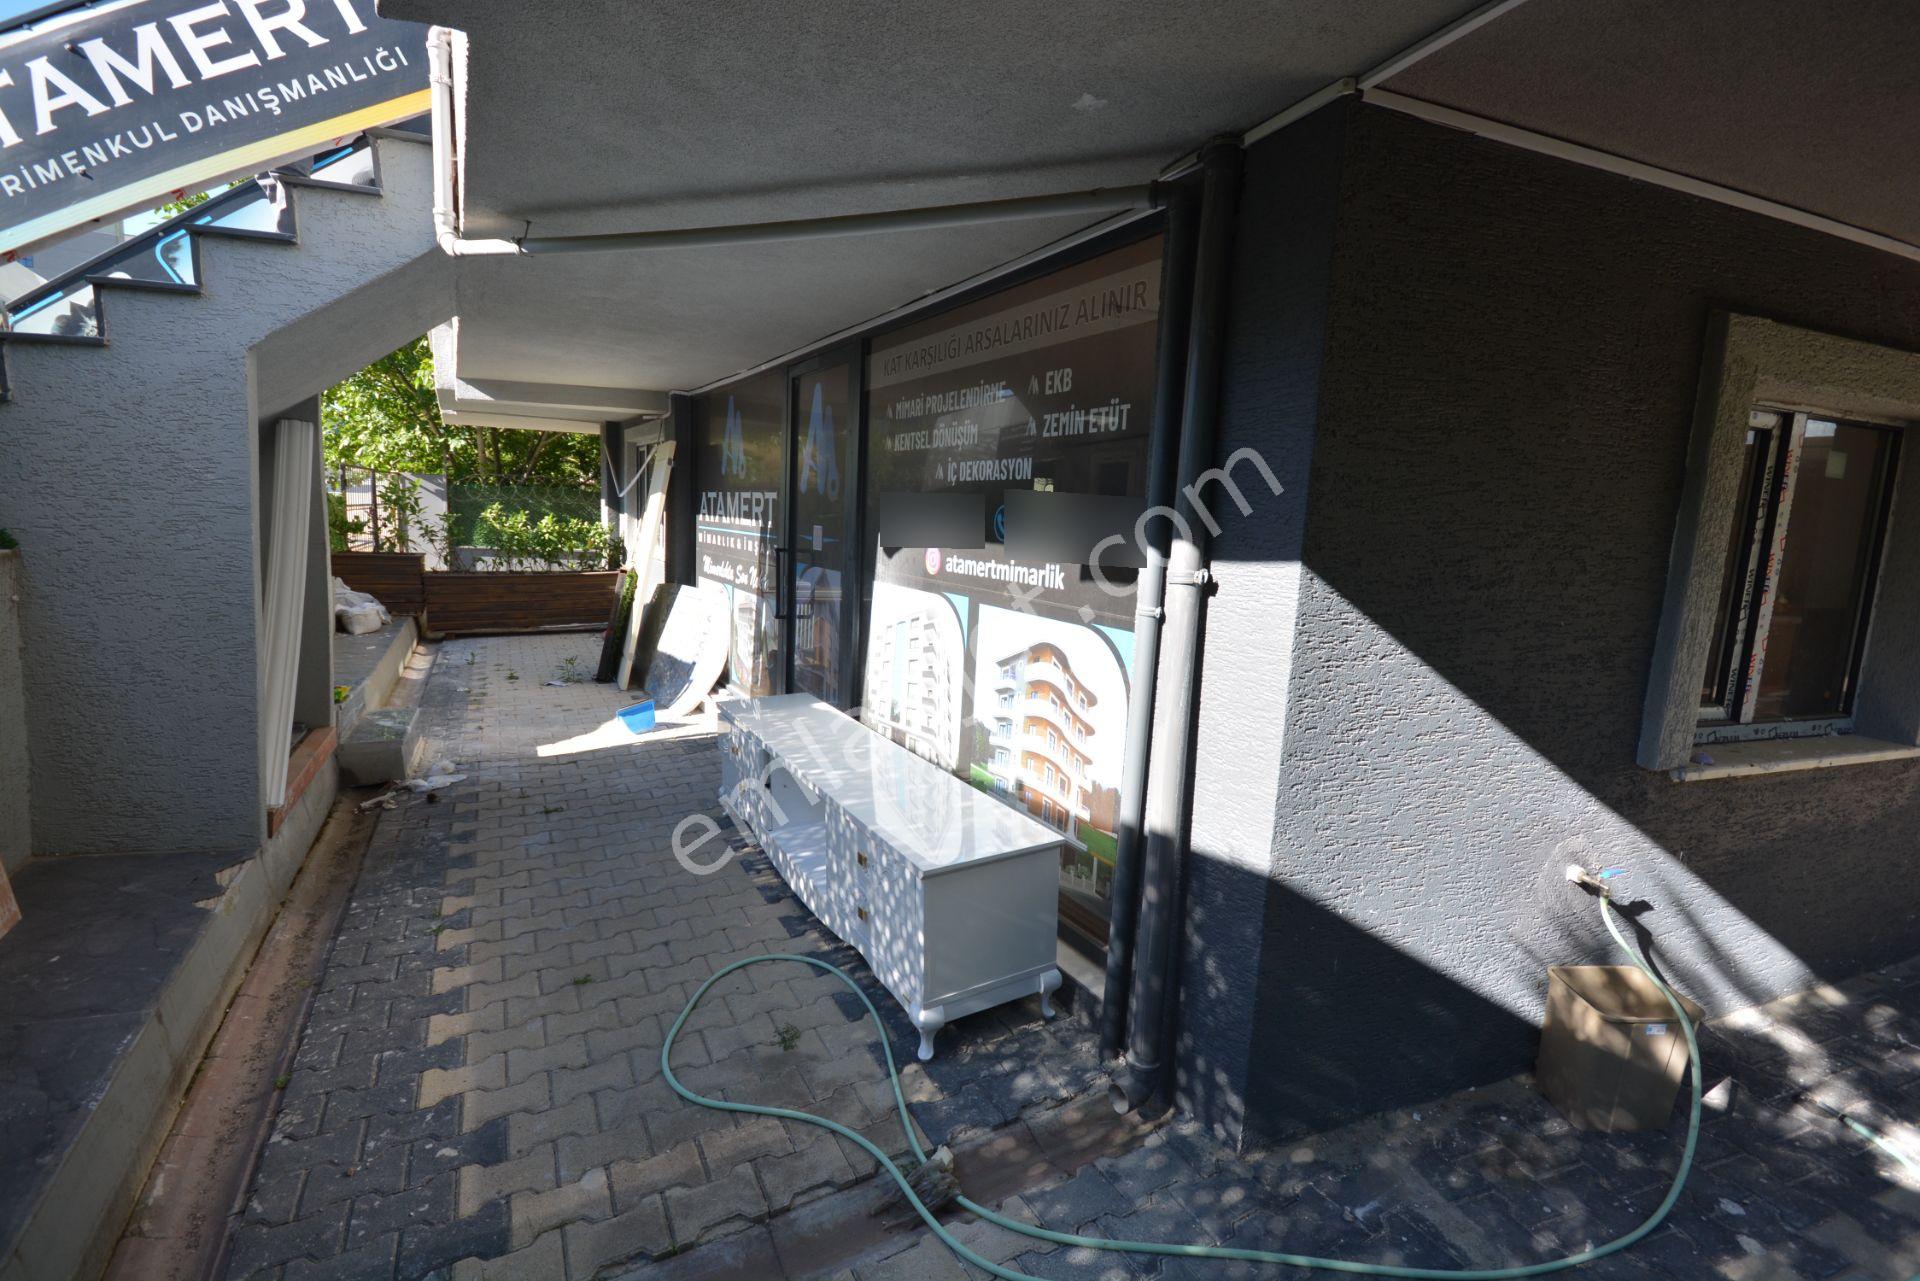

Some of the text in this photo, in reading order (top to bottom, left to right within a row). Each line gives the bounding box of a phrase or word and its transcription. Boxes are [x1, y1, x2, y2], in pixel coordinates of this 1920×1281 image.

[0, 44, 409, 198] RİMENKUL DANIŞMANLIĞI
[883, 280, 1147, 377] KAT KARŞILIĞI ARSALARINIZ ALINIR
[1045, 367, 1073, 395] EKB
[895, 393, 924, 420] MİMARİ
[1042, 397, 1131, 438] ZEMİN ETÜT
[893, 421, 978, 452] KENTSEL DÖNÜŞÜM
[947, 456, 1033, 486] İÇ DEKORASYON
[699, 491, 777, 528] ATAMERT
[945, 554, 1065, 590] atamertmimarlik
